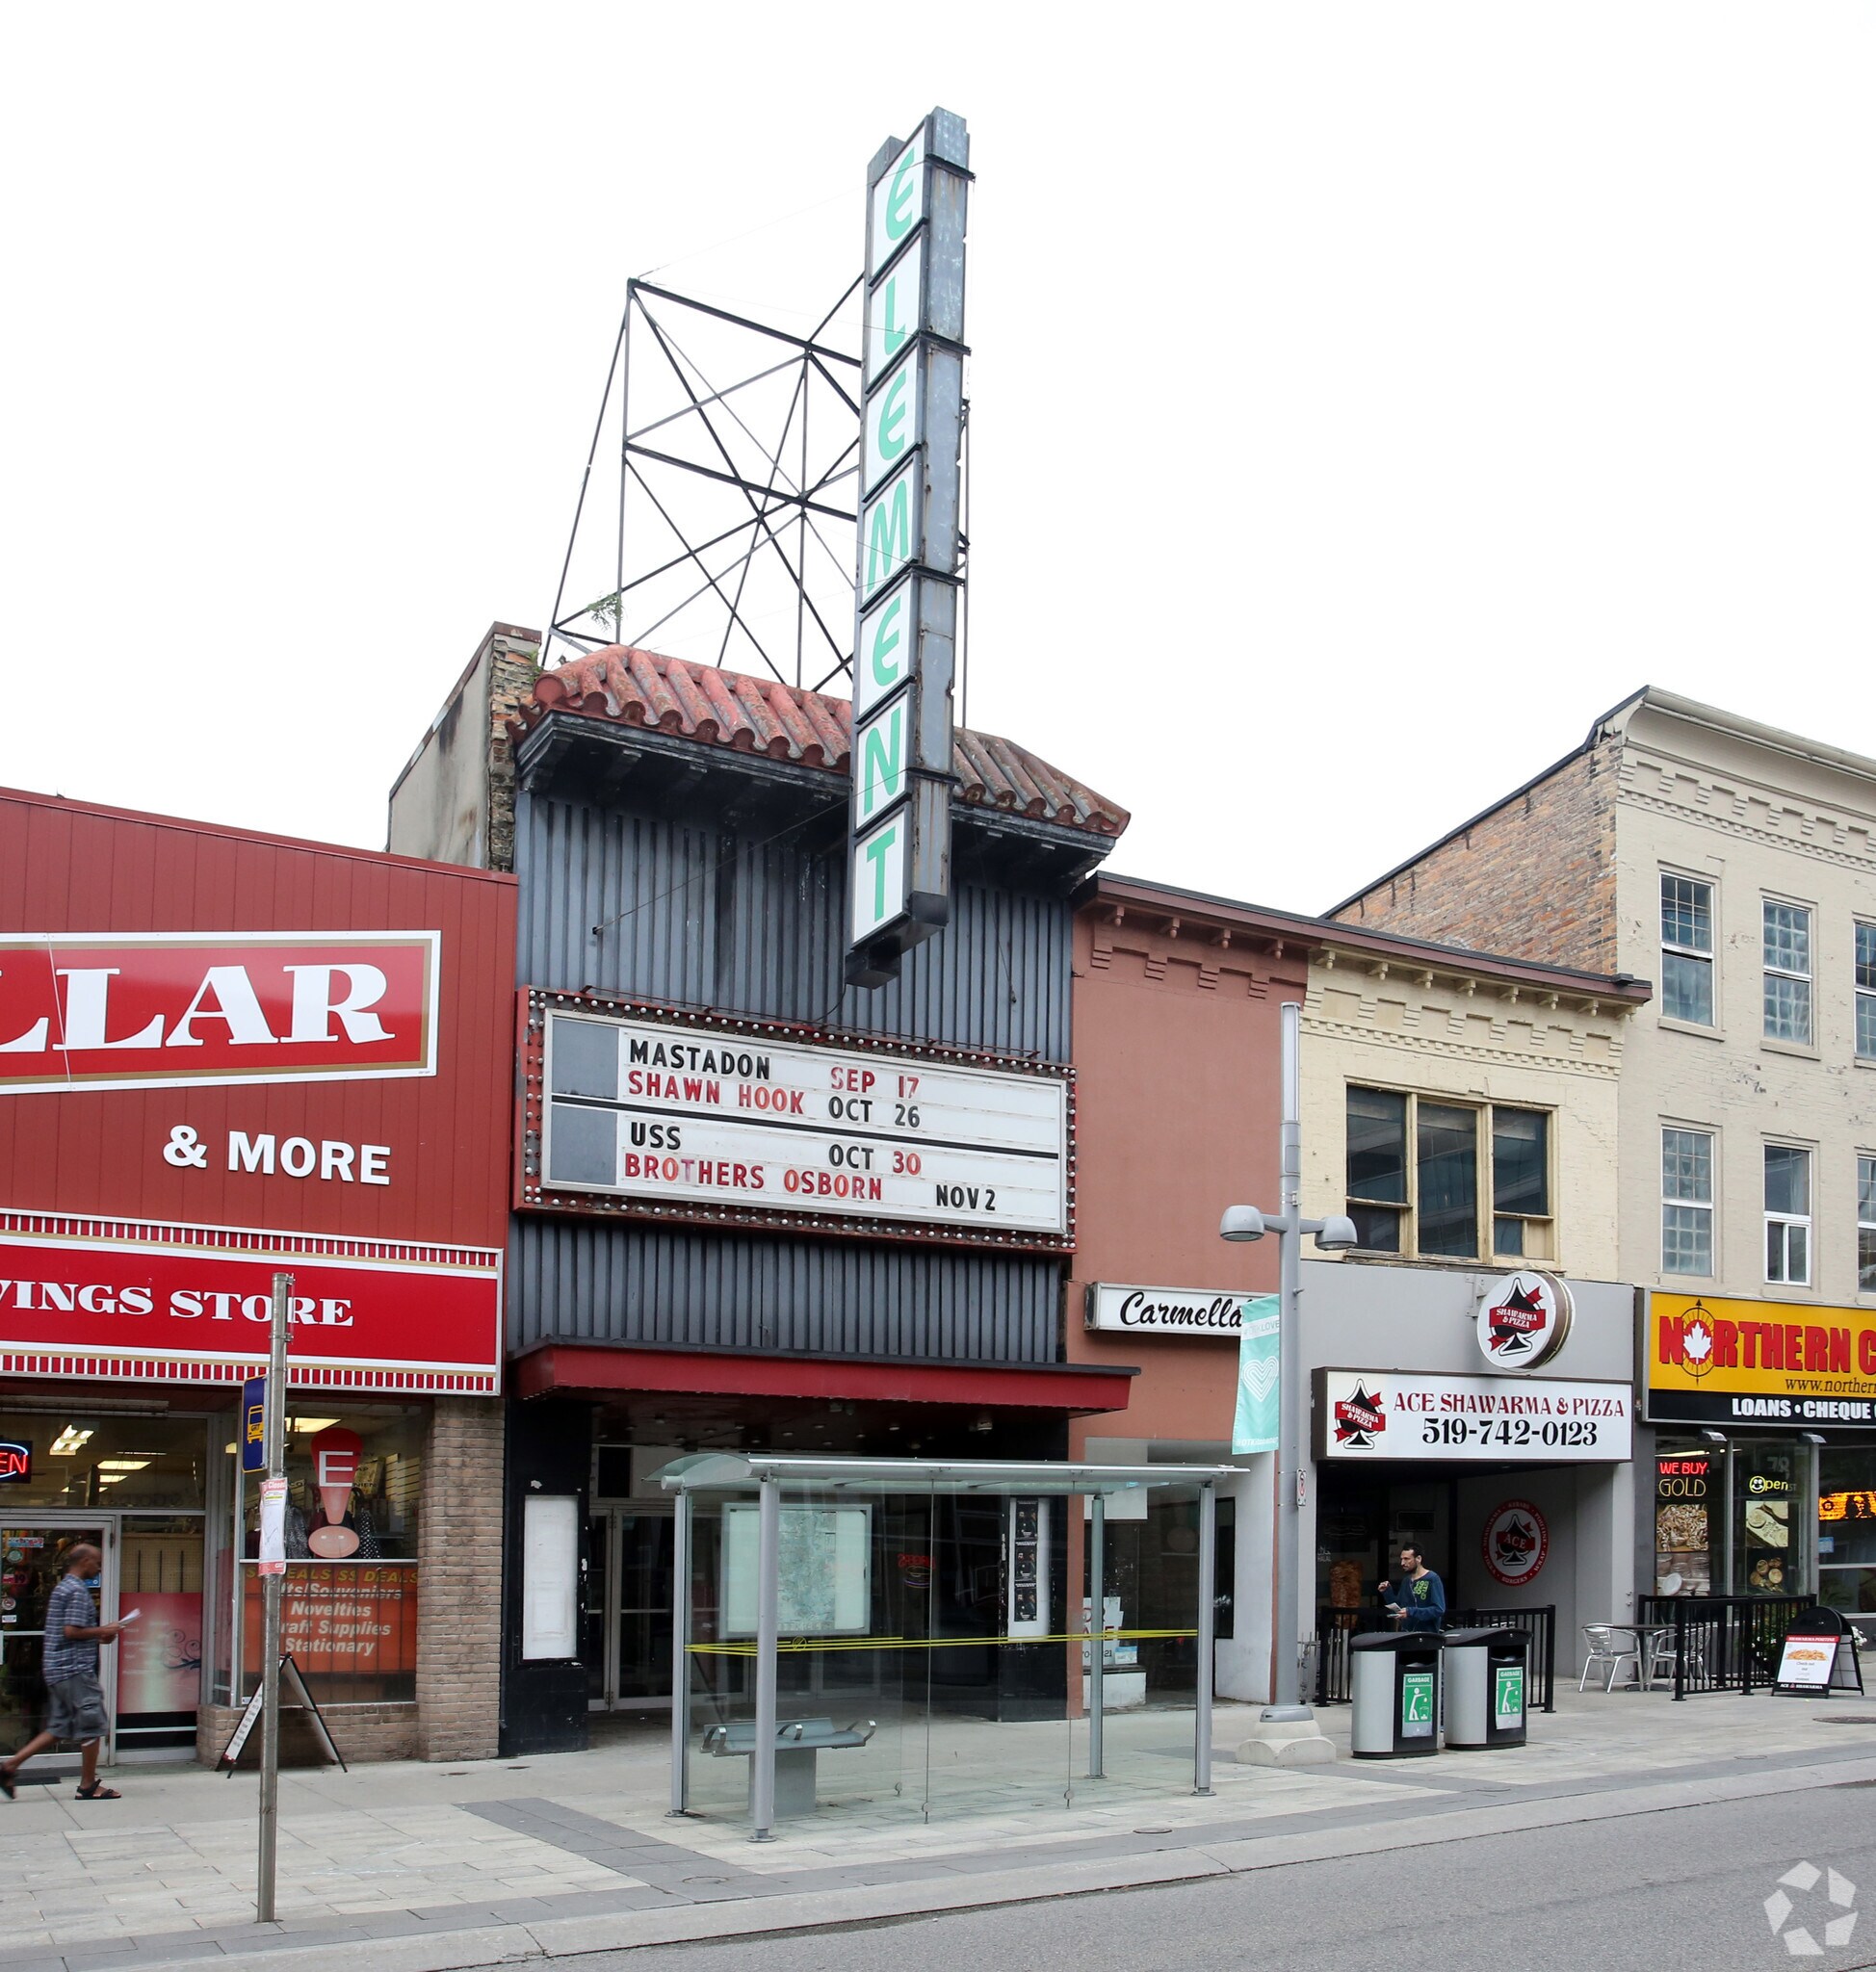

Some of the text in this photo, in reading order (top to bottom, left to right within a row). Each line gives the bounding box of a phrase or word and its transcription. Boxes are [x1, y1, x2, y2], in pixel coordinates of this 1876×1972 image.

[864, 146, 915, 923] ELEMENT
[629, 1038, 920, 1099] MASTADON SEP 17
[628, 1070, 921, 1128] SHAWN HOOK OCT 26
[163, 1125, 391, 1184] & MORE
[631, 1121, 922, 1176] USS OCT 30
[624, 1152, 765, 1189] BROTHERS
[784, 1168, 882, 1201] OSBORN
[169, 1289, 353, 1327] STORE
[1495, 1307, 1538, 1323] SHAWARMA
[1509, 1316, 1530, 1329] PIZZA
[1341, 1402, 1379, 1424] SHAWARMA
[1394, 1391, 1625, 1417] ACE SHAWARMA & PIZZA
[1732, 1398, 1871, 1421] LOANS CHEQUE
[1352, 1413, 1372, 1429] PIZZA
[1422, 1417, 1598, 1446] 519-742-0123
[1659, 1462, 1708, 1475] WE BUY
[1658, 1476, 1707, 1497] GOLD
[1503, 1533, 1527, 1549] ACE
[288, 1568, 332, 1581] EALS
[291, 1600, 372, 1618] Novelties
[280, 1620, 392, 1639] raft Supplies
[285, 1637, 375, 1657] Stationary
